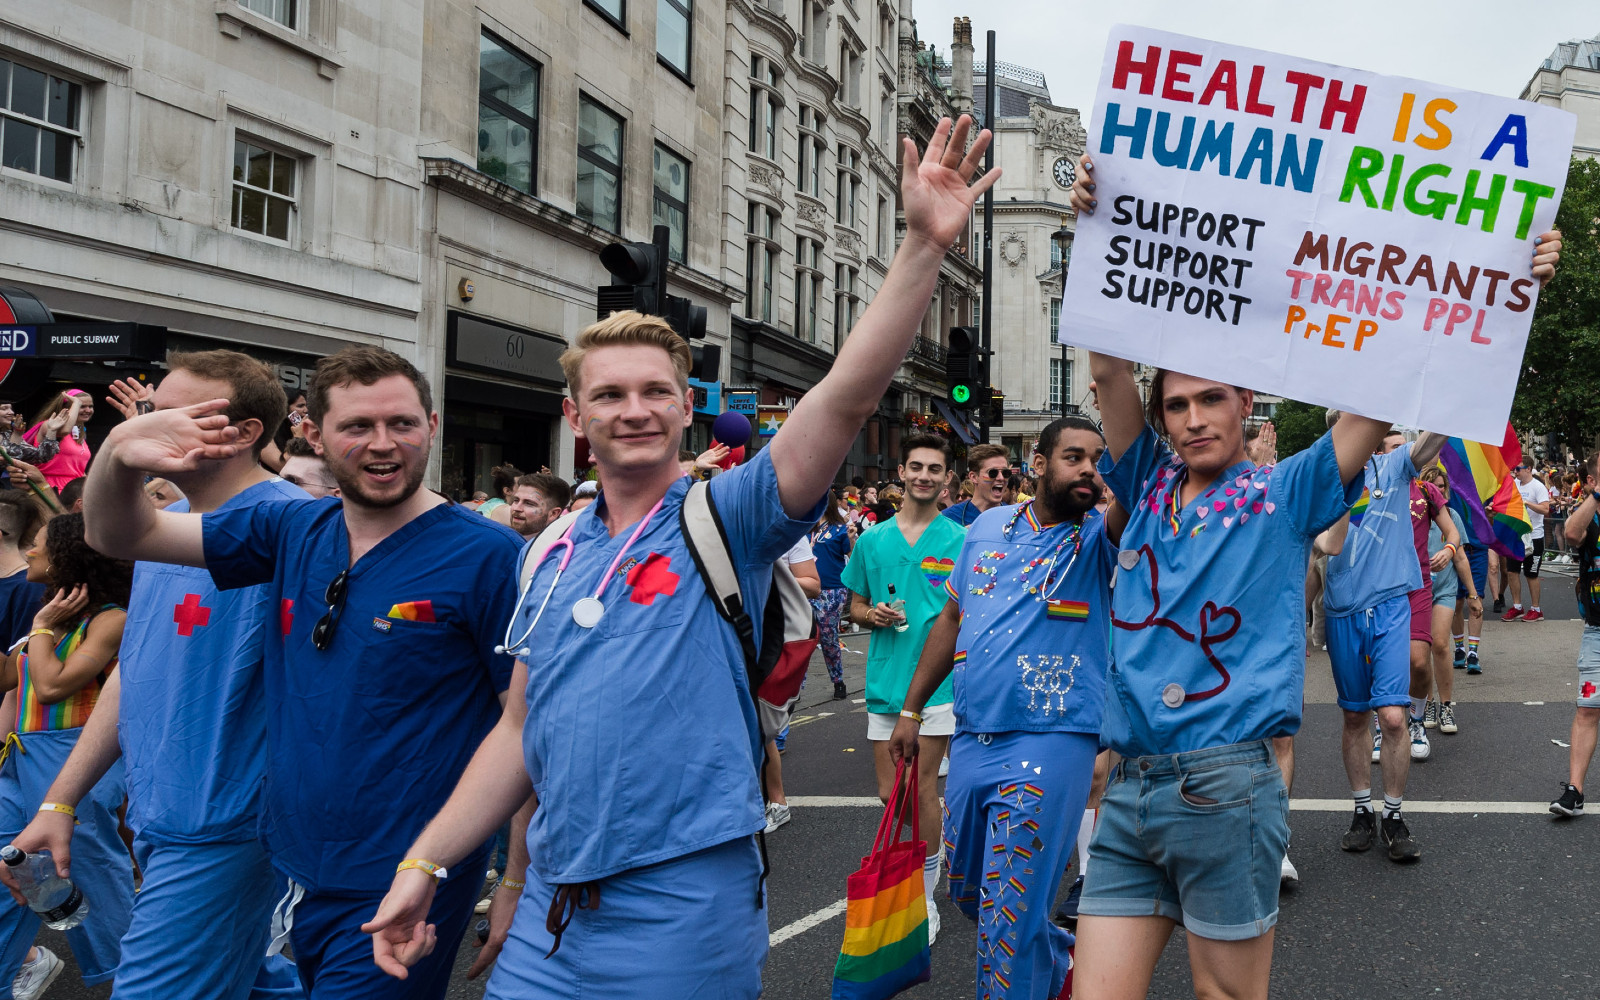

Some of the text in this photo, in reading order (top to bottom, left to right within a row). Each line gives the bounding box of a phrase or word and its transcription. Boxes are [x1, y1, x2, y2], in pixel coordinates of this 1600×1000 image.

[1112, 40, 1530, 169] HEALTH IS A
[1099, 101, 1556, 241] HUMAN RIGHT
[1104, 234, 1492, 345] SUPPORT TRANS PPL
[1111, 194, 1534, 313] SUPPORT MIGRANTS
[0, 329, 29, 352] ND
[51, 335, 120, 344] PUBLIC SUBWAY
[506, 334, 524, 360] 60
[1100, 269, 1379, 352] SUPPORT PrEP
[620, 560, 636, 575] NHS
